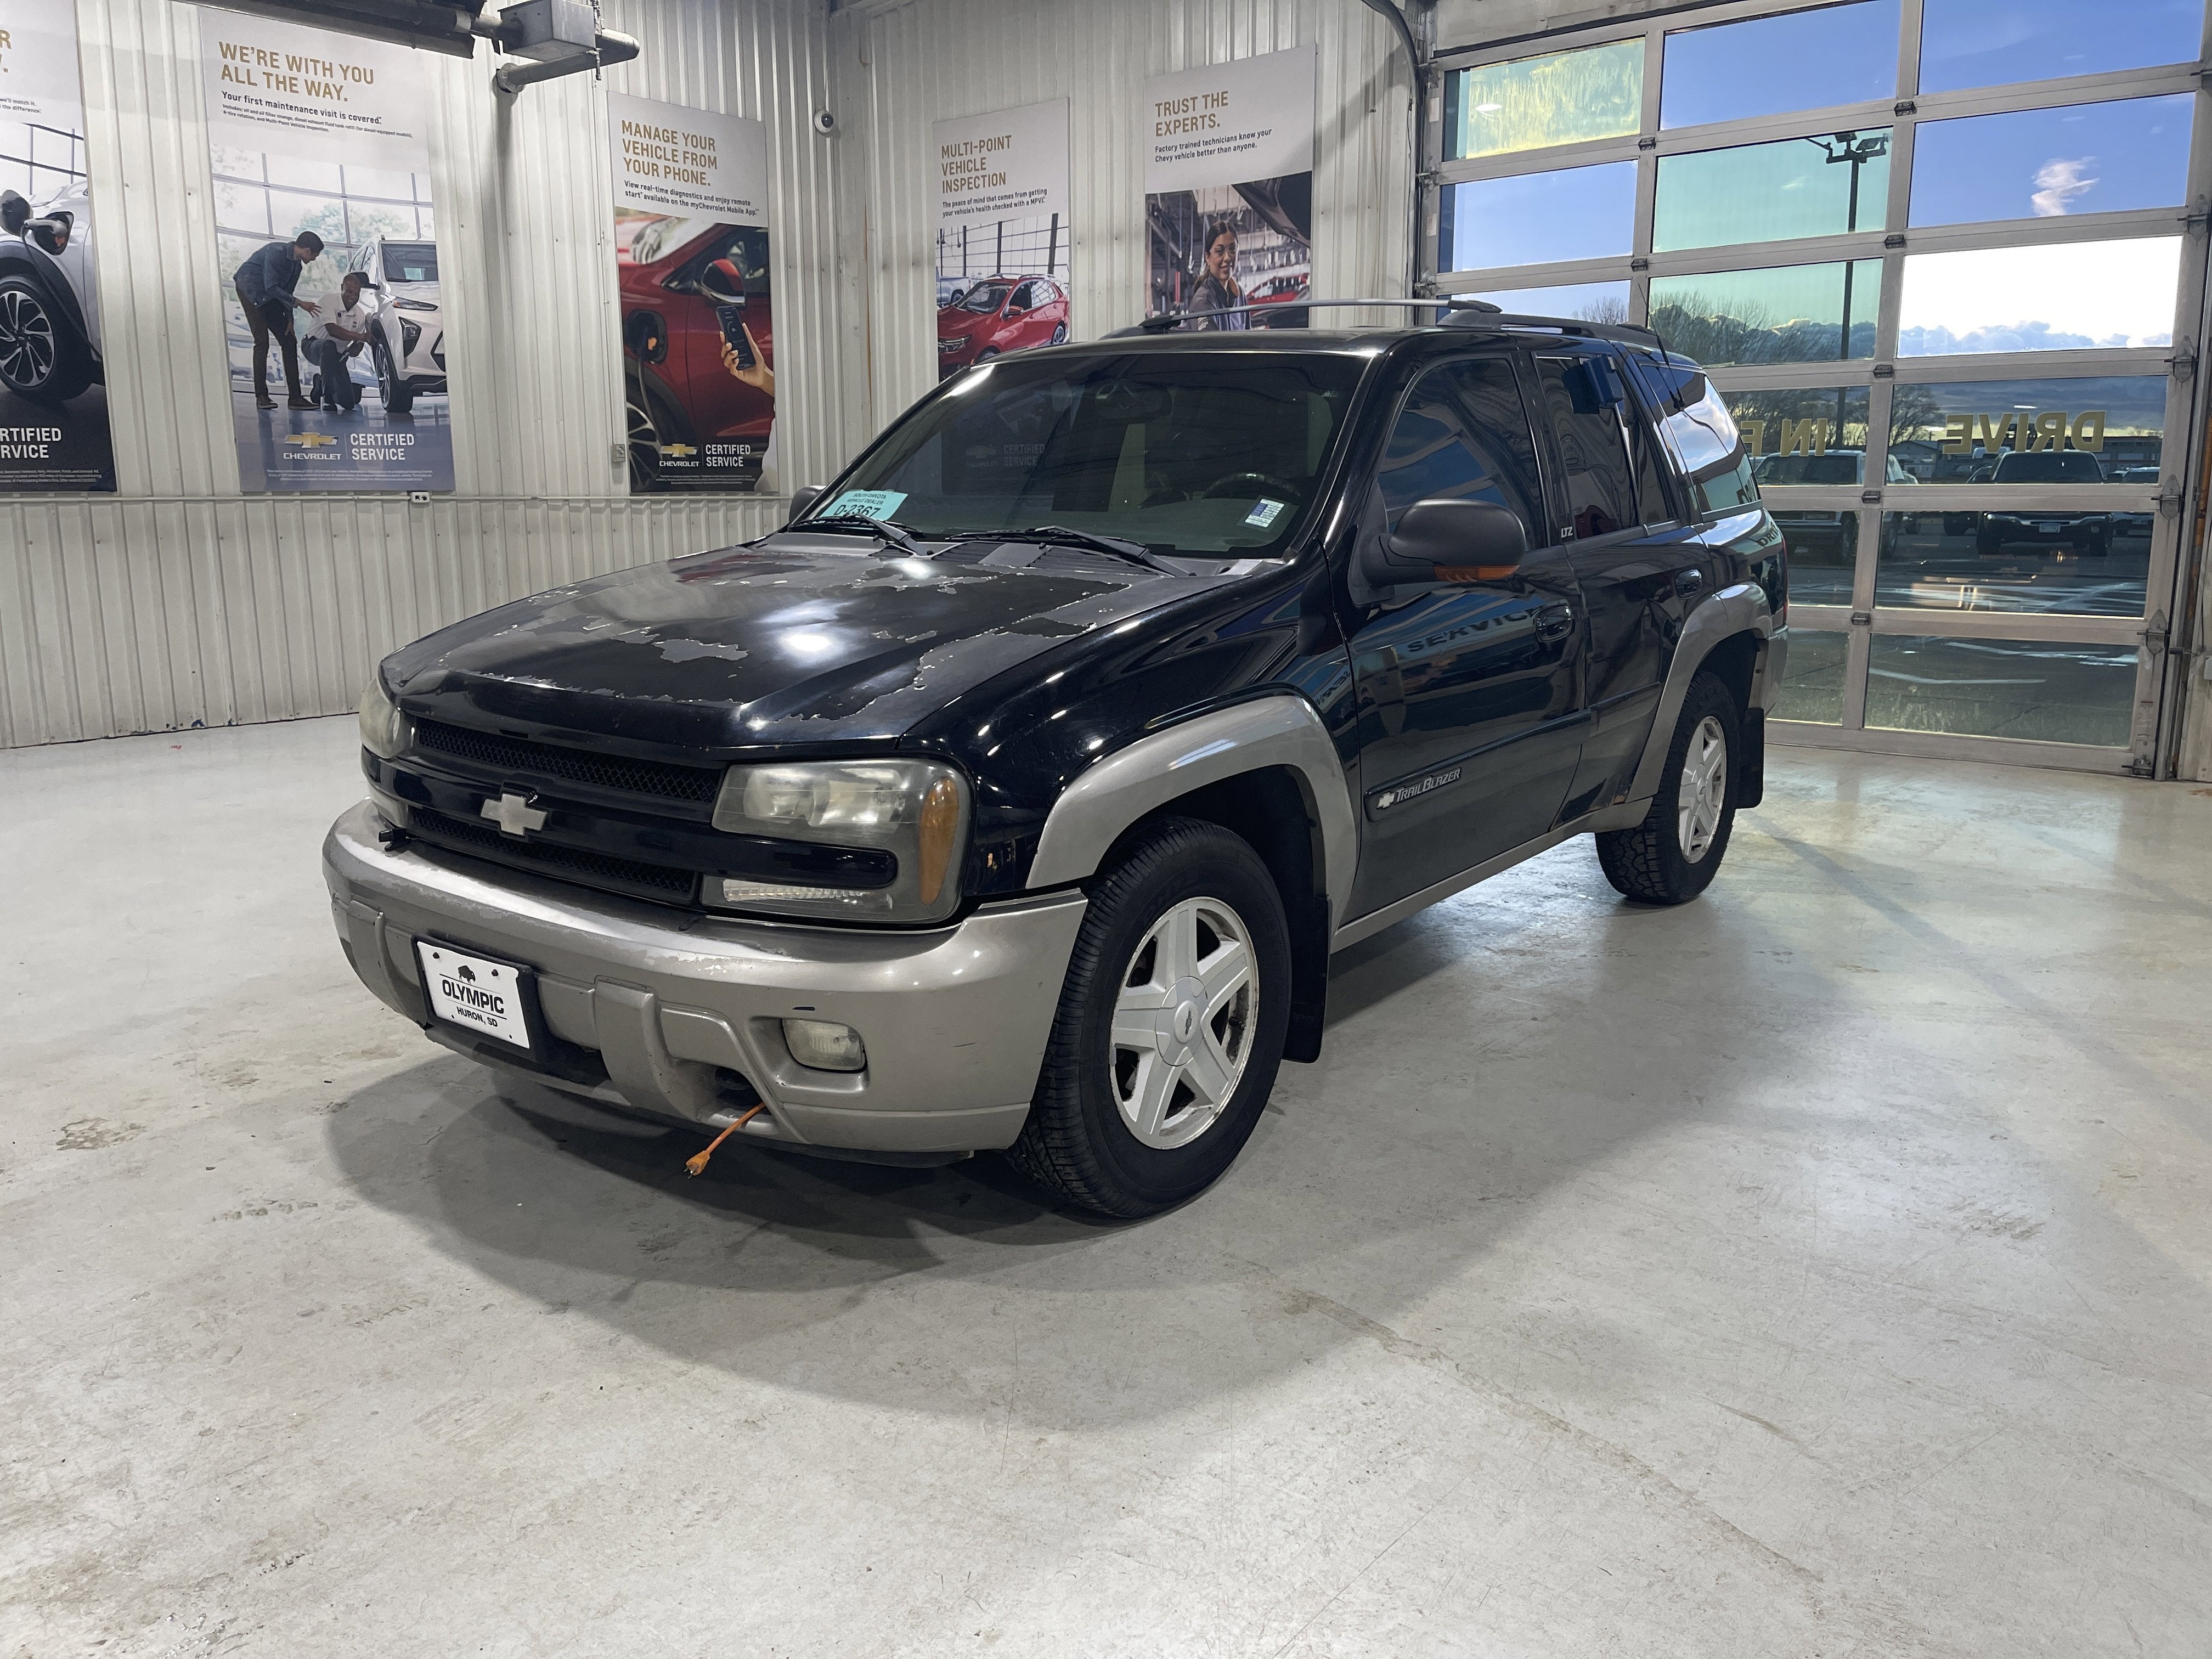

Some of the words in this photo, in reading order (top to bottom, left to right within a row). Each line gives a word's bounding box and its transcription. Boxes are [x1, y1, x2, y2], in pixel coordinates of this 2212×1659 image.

[219, 41, 280, 69] WE'RE
[285, 54, 333, 79] WITH
[338, 63, 374, 85] YOU
[221, 64, 258, 87] ALL
[262, 71, 299, 94] THE
[304, 79, 348, 101] WAY.
[222, 91, 242, 103] Your
[244, 95, 263, 106] first
[265, 99, 318, 116] maintenance
[320, 108, 338, 119] visit
[339, 110, 347, 120] is
[1155, 96, 1198, 118] TRUST
[1202, 91, 1228, 109] THE
[622, 120, 679, 145] MANAGE
[682, 132, 716, 152] YOUR
[1155, 113, 1221, 137] EXPERTS.
[941, 134, 1012, 159] MULTI-POINT
[1155, 144, 1178, 154] Factory
[1180, 140, 1201, 150] trained
[1203, 134, 1237, 146] technicians
[1239, 131, 1256, 140] know
[1257, 129, 1272, 139] your
[1155, 153, 1173, 163] Chevy
[1175, 150, 1195, 160] vehicle
[1197, 148, 1216, 157] better
[1217, 146, 1232, 154] than
[1233, 142, 1257, 153] anyone.
[622, 138, 679, 163] VEHICLE
[683, 150, 718, 170] FROM
[623, 157, 659, 178] YOUR
[664, 165, 711, 187] PHONE.
[941, 157, 987, 176] VEHICLE
[624, 179, 639, 188] View
[640, 184, 669, 194] real-time
[670, 189, 703, 200] diagnostics
[715, 196, 730, 205] enjoy
[942, 172, 1006, 194] INSPECTION
[644, 194, 669, 204] available
[690, 201, 726, 212] myChevrolet
[727, 206, 744, 214] Mobile
[942, 210, 953, 218] your
[954, 207, 975, 215] vehicle's
[975, 205, 991, 213] health
[992, 201, 1013, 211] checked
[1013, 199, 1025, 207] with
[952, 200, 966, 209] peace
[973, 196, 985, 204] mind
[1028, 188, 1048, 198] getting
[350, 433, 415, 447] CERTIFIED
[705, 444, 751, 455] CERTIFIED
[351, 448, 406, 461] SERVICE
[706, 456, 744, 467] SERVICE
[833, 504, 882, 517] D-2367
[1561, 526, 1573, 538] LTZ
[442, 979, 504, 1014] OLYMPIC
[456, 1006, 486, 1025] HURON,
[487, 1017, 498, 1028] SD
